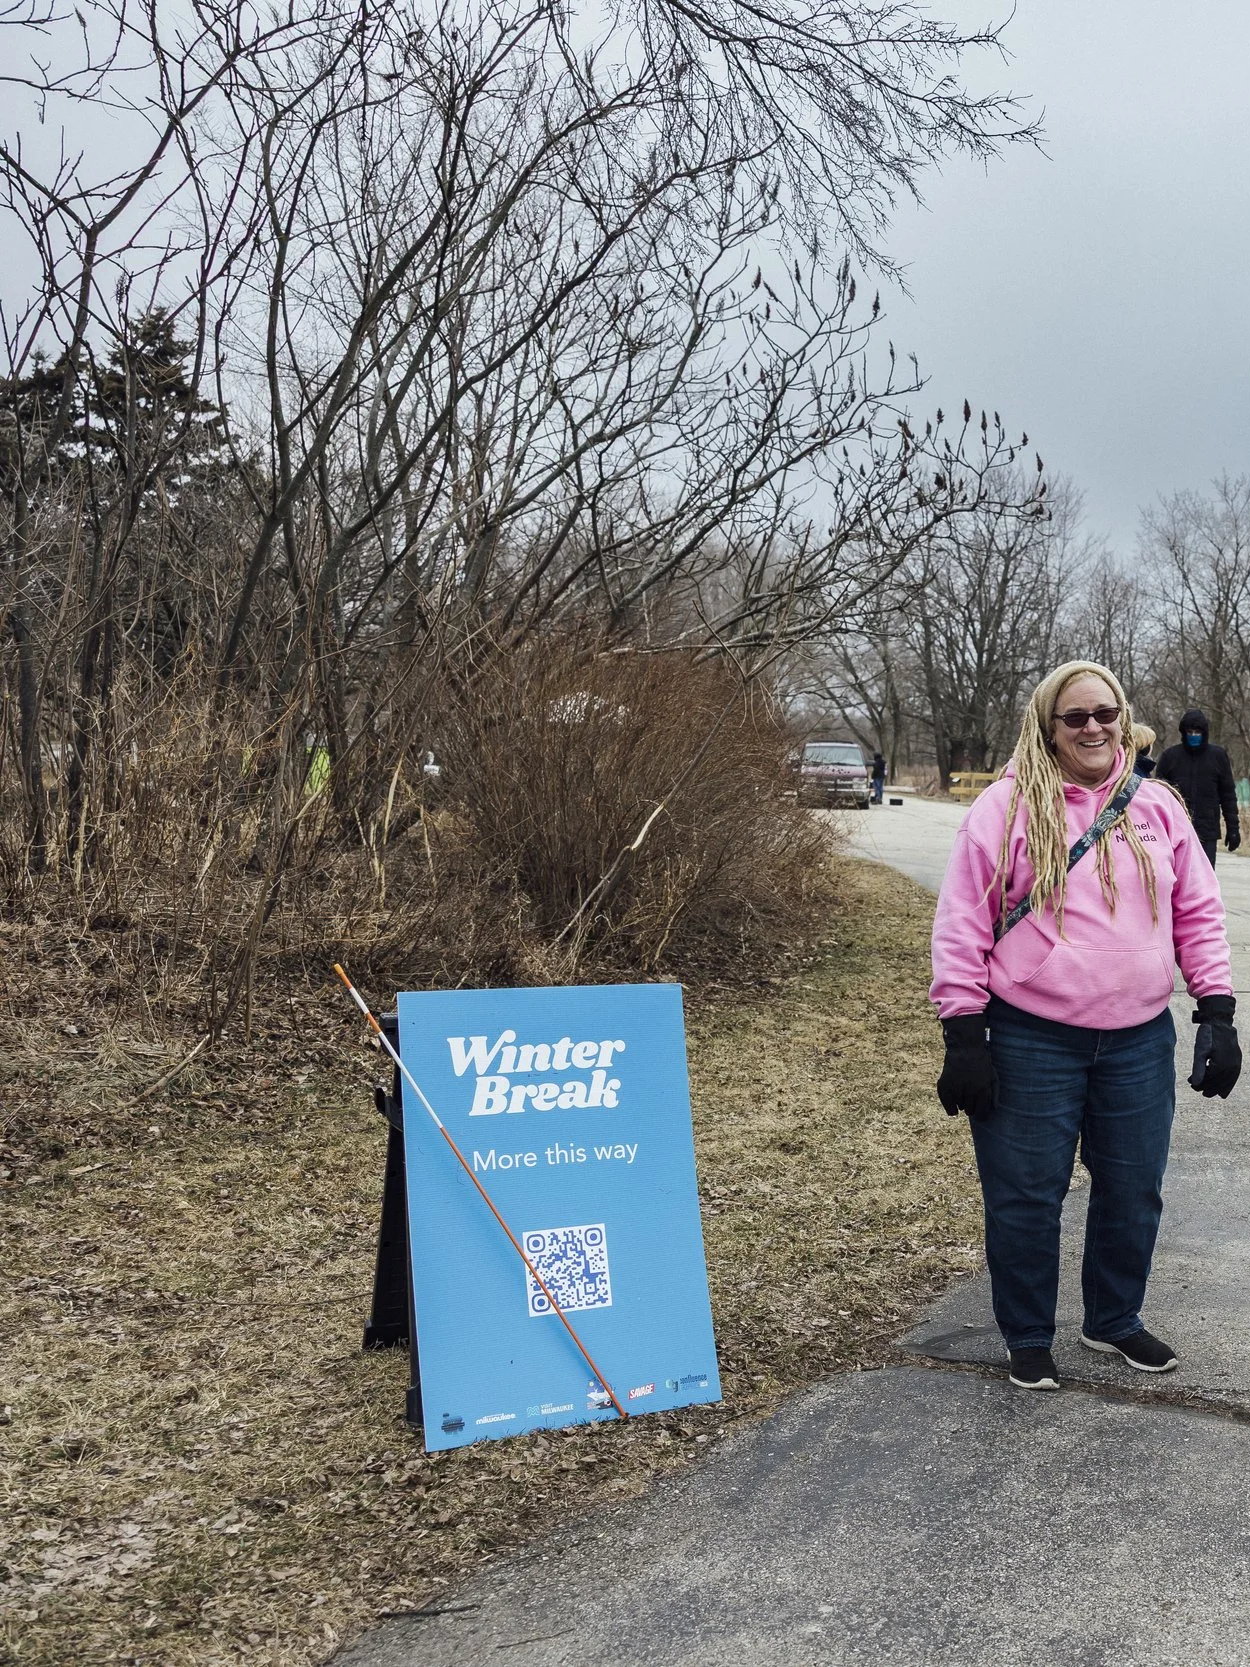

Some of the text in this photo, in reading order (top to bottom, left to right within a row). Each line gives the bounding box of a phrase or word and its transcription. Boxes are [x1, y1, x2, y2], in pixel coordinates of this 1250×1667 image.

[446, 1029, 626, 1077] Winter
[468, 1069, 622, 1116] Break
[473, 1142, 639, 1172] More this way
[629, 1383, 654, 1399] SAVAGE
[475, 1412, 516, 1425] milwaukee
[541, 1403, 574, 1415] MILWAUKEE
